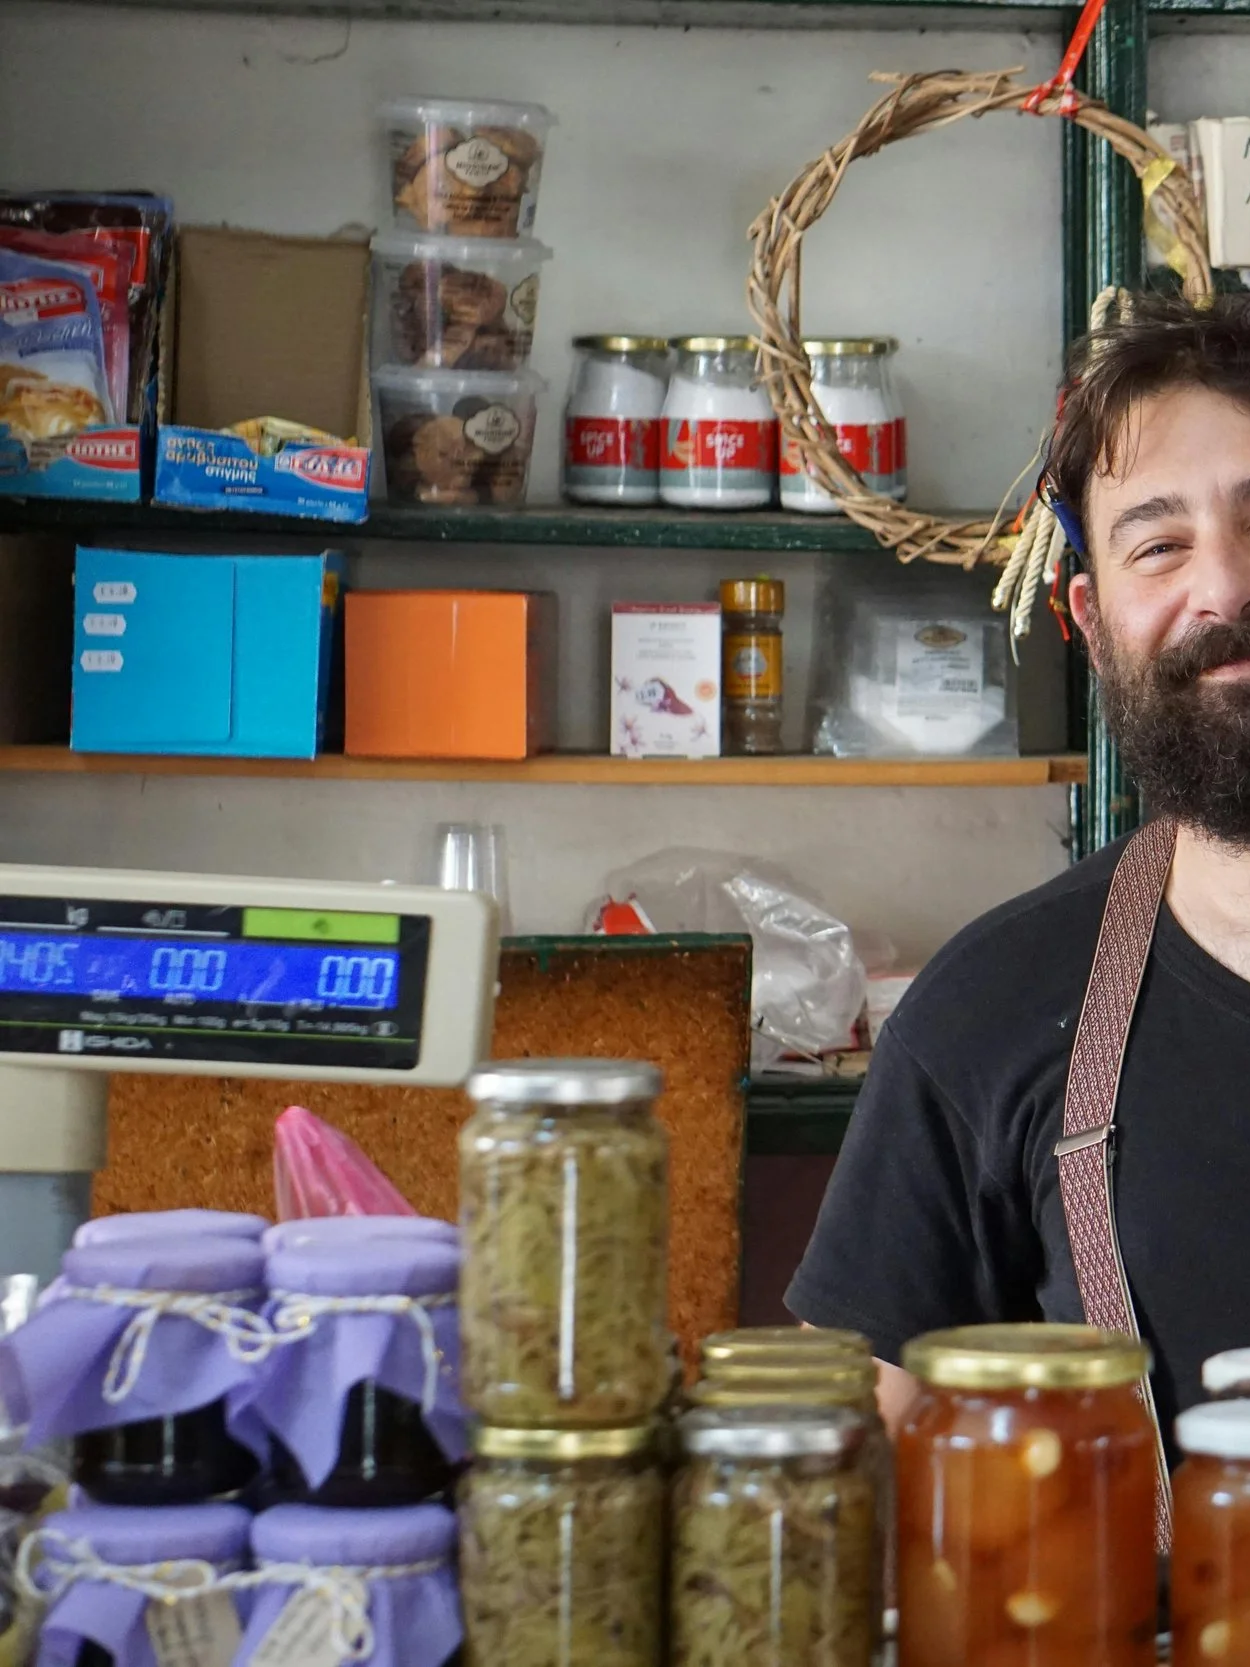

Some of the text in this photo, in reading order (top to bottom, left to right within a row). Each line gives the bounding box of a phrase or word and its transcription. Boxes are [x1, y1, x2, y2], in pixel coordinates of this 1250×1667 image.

[580, 430, 614, 445] SPICE
[705, 433, 744, 449] SPICE
[586, 443, 605, 458] UP
[715, 447, 736, 461] UP
